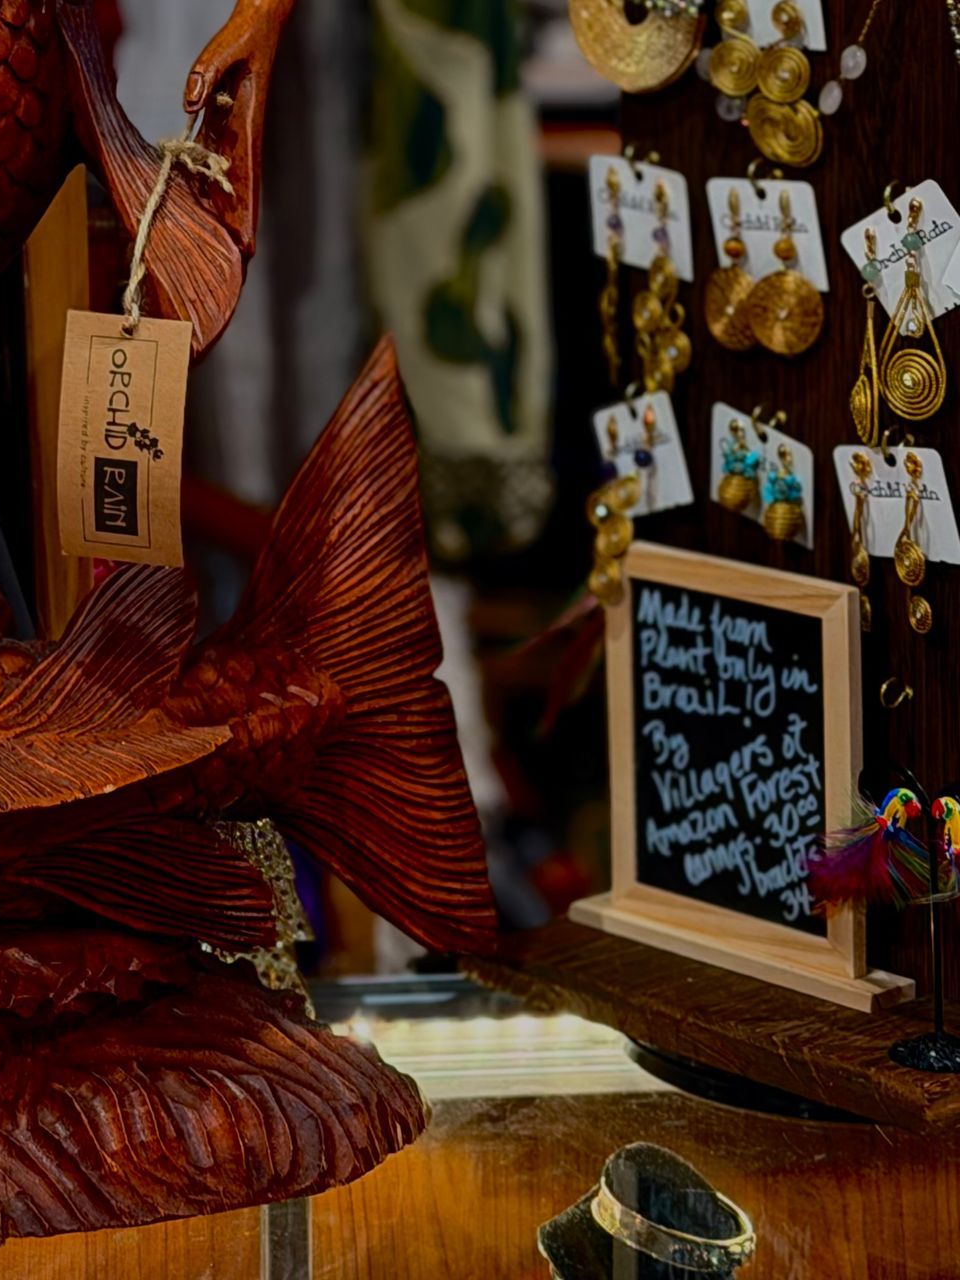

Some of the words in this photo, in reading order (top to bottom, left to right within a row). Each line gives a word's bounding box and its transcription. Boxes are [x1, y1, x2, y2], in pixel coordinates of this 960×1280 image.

[874, 243, 911, 273] Orch
[915, 220, 954, 246] Rain
[104, 348, 132, 451] ORCHID
[103, 465, 127, 528] RAIN
[638, 588, 705, 632] Made
[710, 600, 773, 656] from
[718, 646, 777, 717] only
[781, 653, 818, 695] in
[642, 719, 690, 770] By
[651, 734, 774, 813] Villagers
[646, 803, 739, 857] Amazon
[739, 753, 822, 819] Forest
